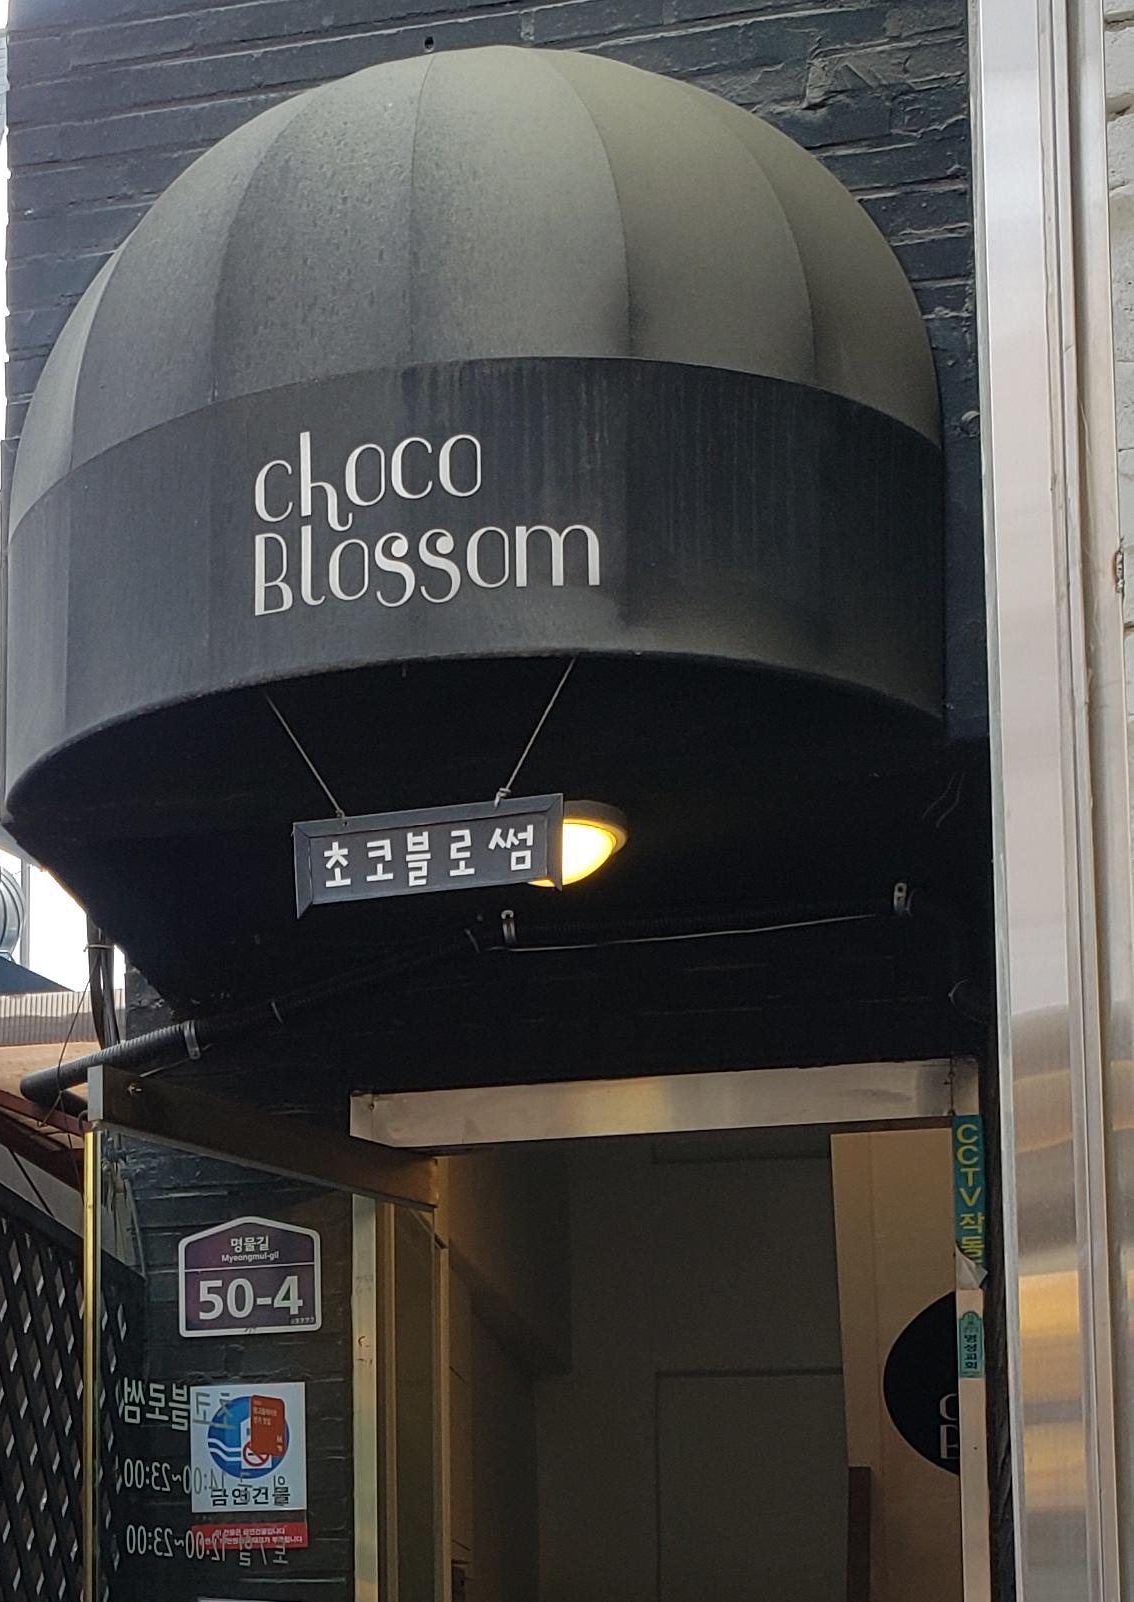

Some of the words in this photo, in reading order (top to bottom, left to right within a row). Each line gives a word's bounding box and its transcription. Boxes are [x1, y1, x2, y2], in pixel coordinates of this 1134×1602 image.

[254, 431, 482, 532] choco
[254, 524, 601, 616] Blossom
[323, 824, 535, 888] 초코블로썸
[230, 1235, 270, 1253] 명물길
[199, 1275, 304, 1321] 50-4
